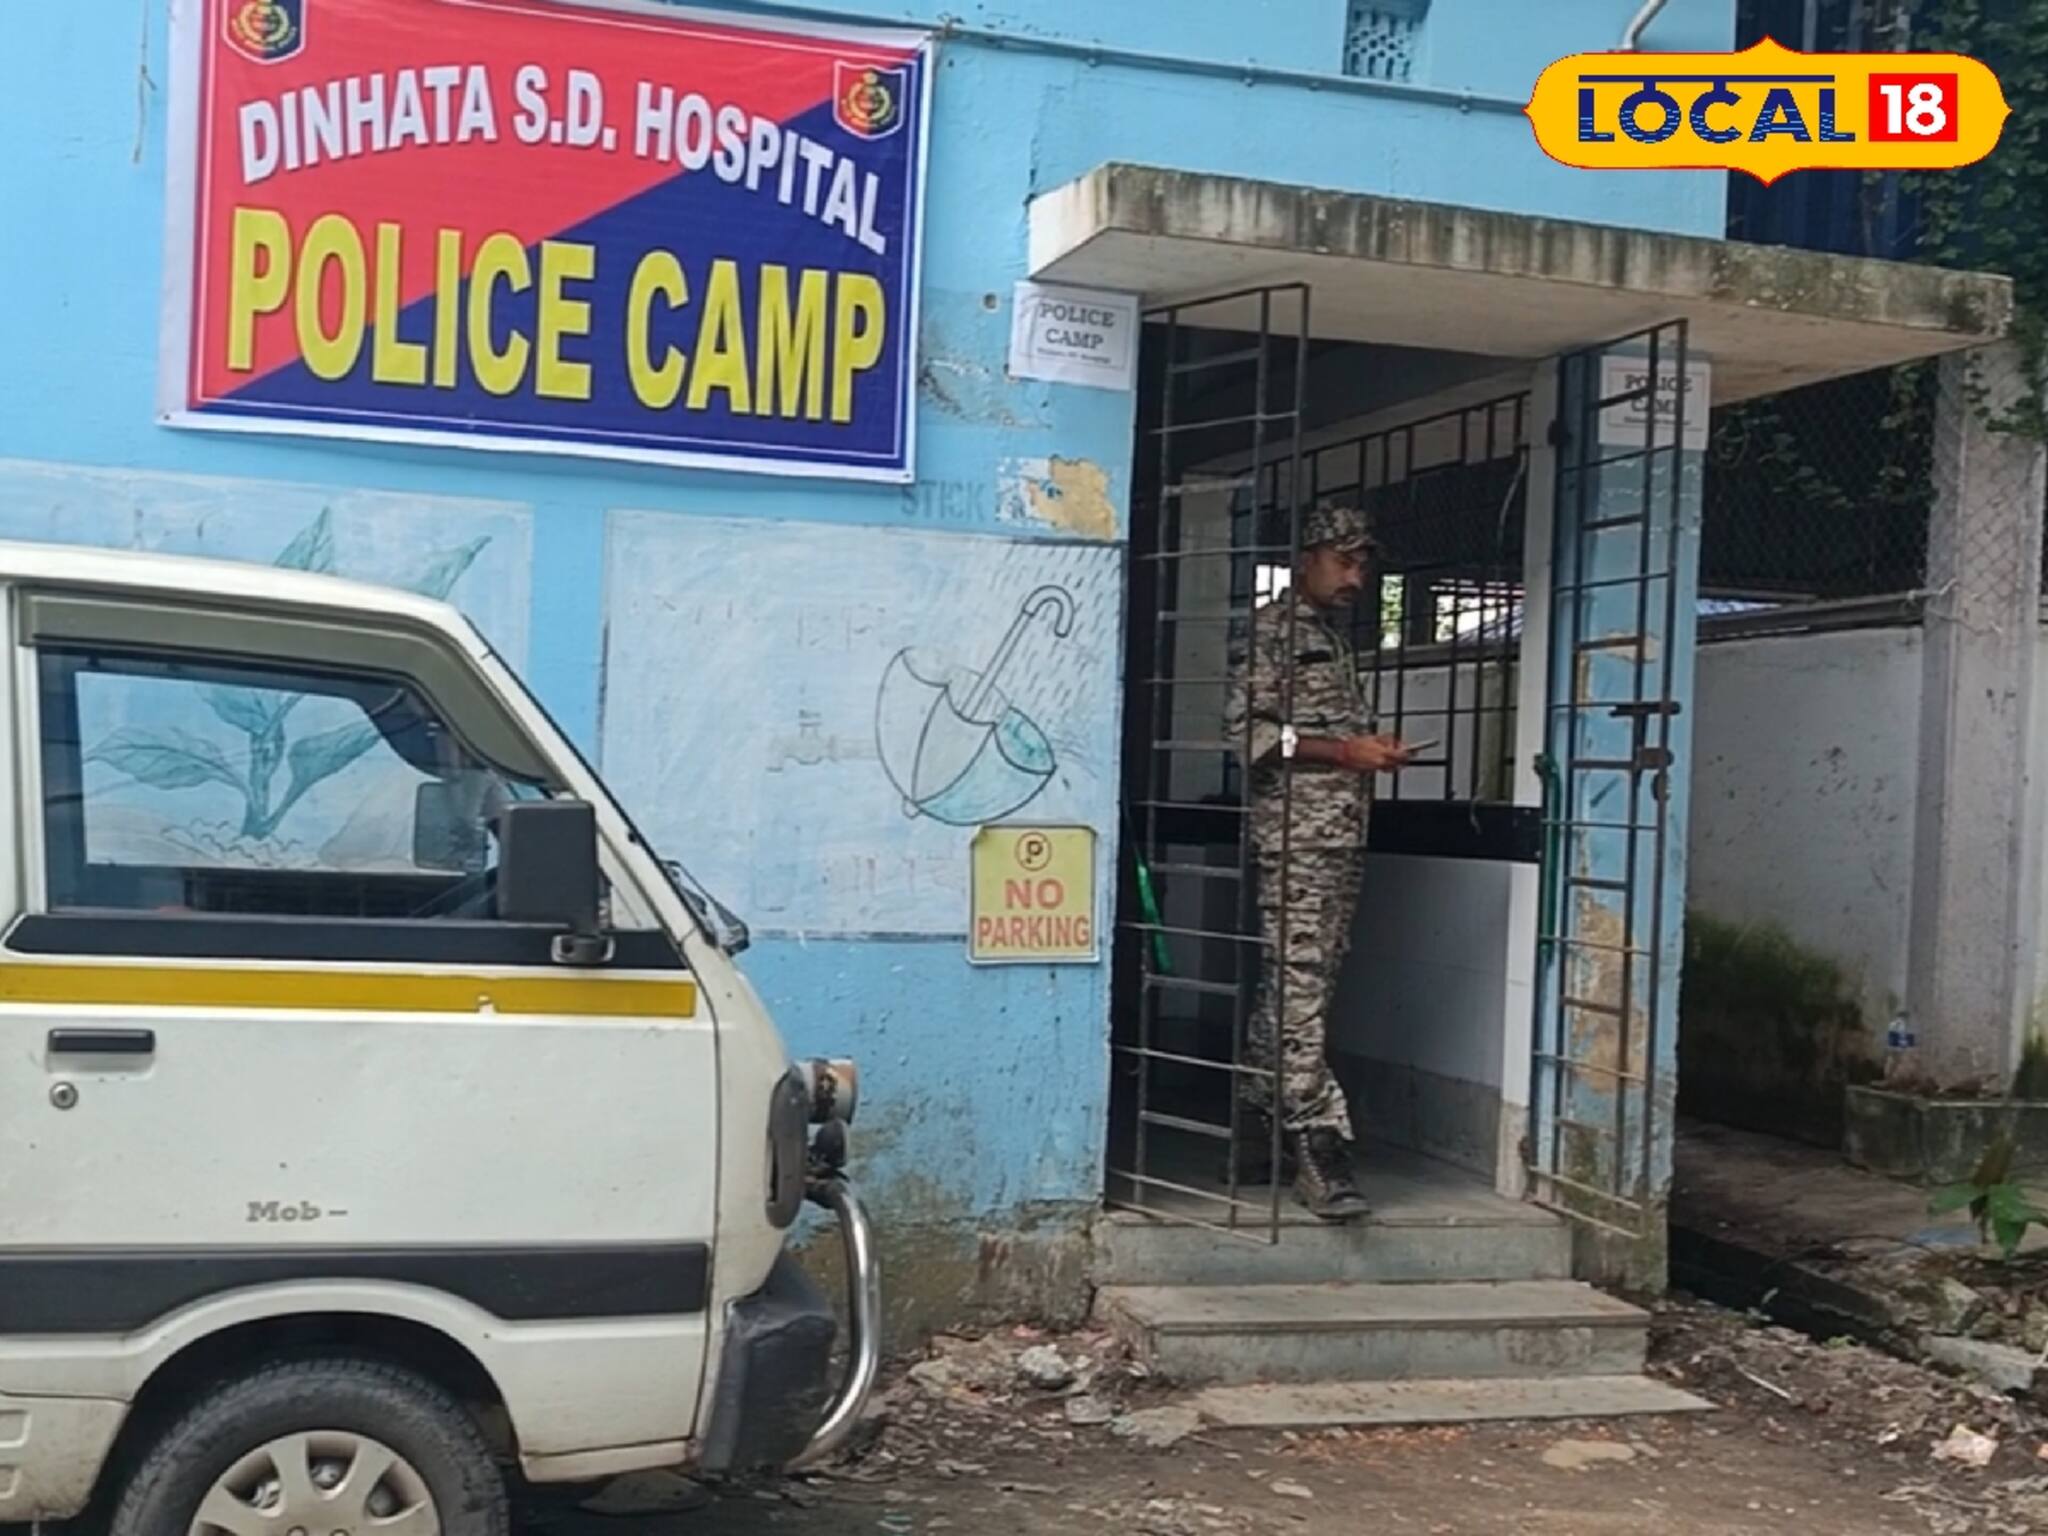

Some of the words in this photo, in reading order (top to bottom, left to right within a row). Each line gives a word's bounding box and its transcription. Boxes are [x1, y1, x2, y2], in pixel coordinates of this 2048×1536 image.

[240, 65, 497, 185] DINHATA
[514, 65, 617, 152] S.D.
[635, 81, 887, 256] HOSPITAL
[227, 206, 596, 399] POLICE
[626, 249, 886, 424] CAMP
[1039, 302, 1115, 328] POLICE
[1045, 328, 1104, 349] CAMP
[1005, 878, 1064, 910] NO
[977, 915, 1090, 948] PARKING
